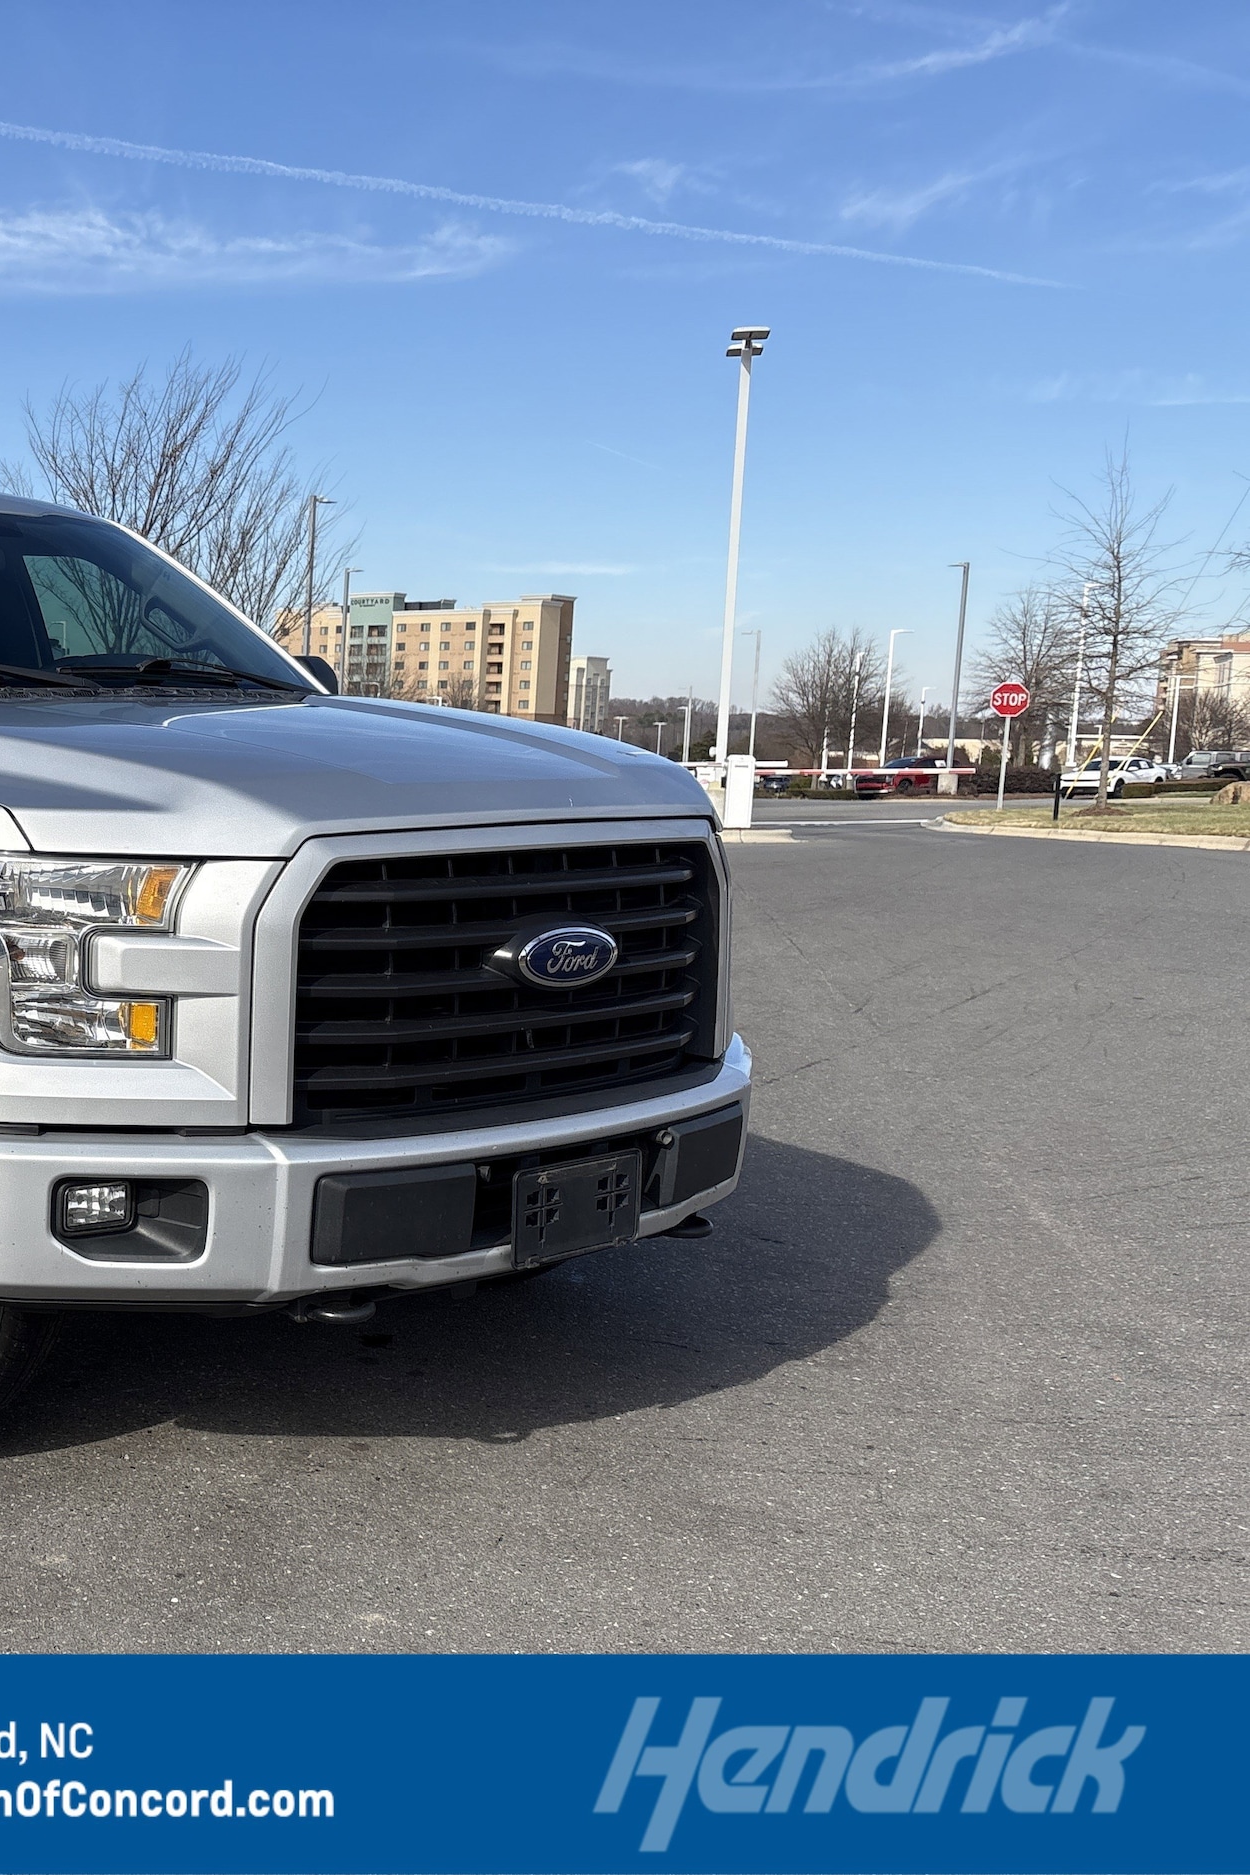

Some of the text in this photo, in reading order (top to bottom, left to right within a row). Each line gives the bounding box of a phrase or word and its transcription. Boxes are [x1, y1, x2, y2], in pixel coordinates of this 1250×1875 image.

[350, 598, 390, 606] COURTYARD
[993, 692, 1027, 707] STOP
[546, 940, 599, 974] Ford
